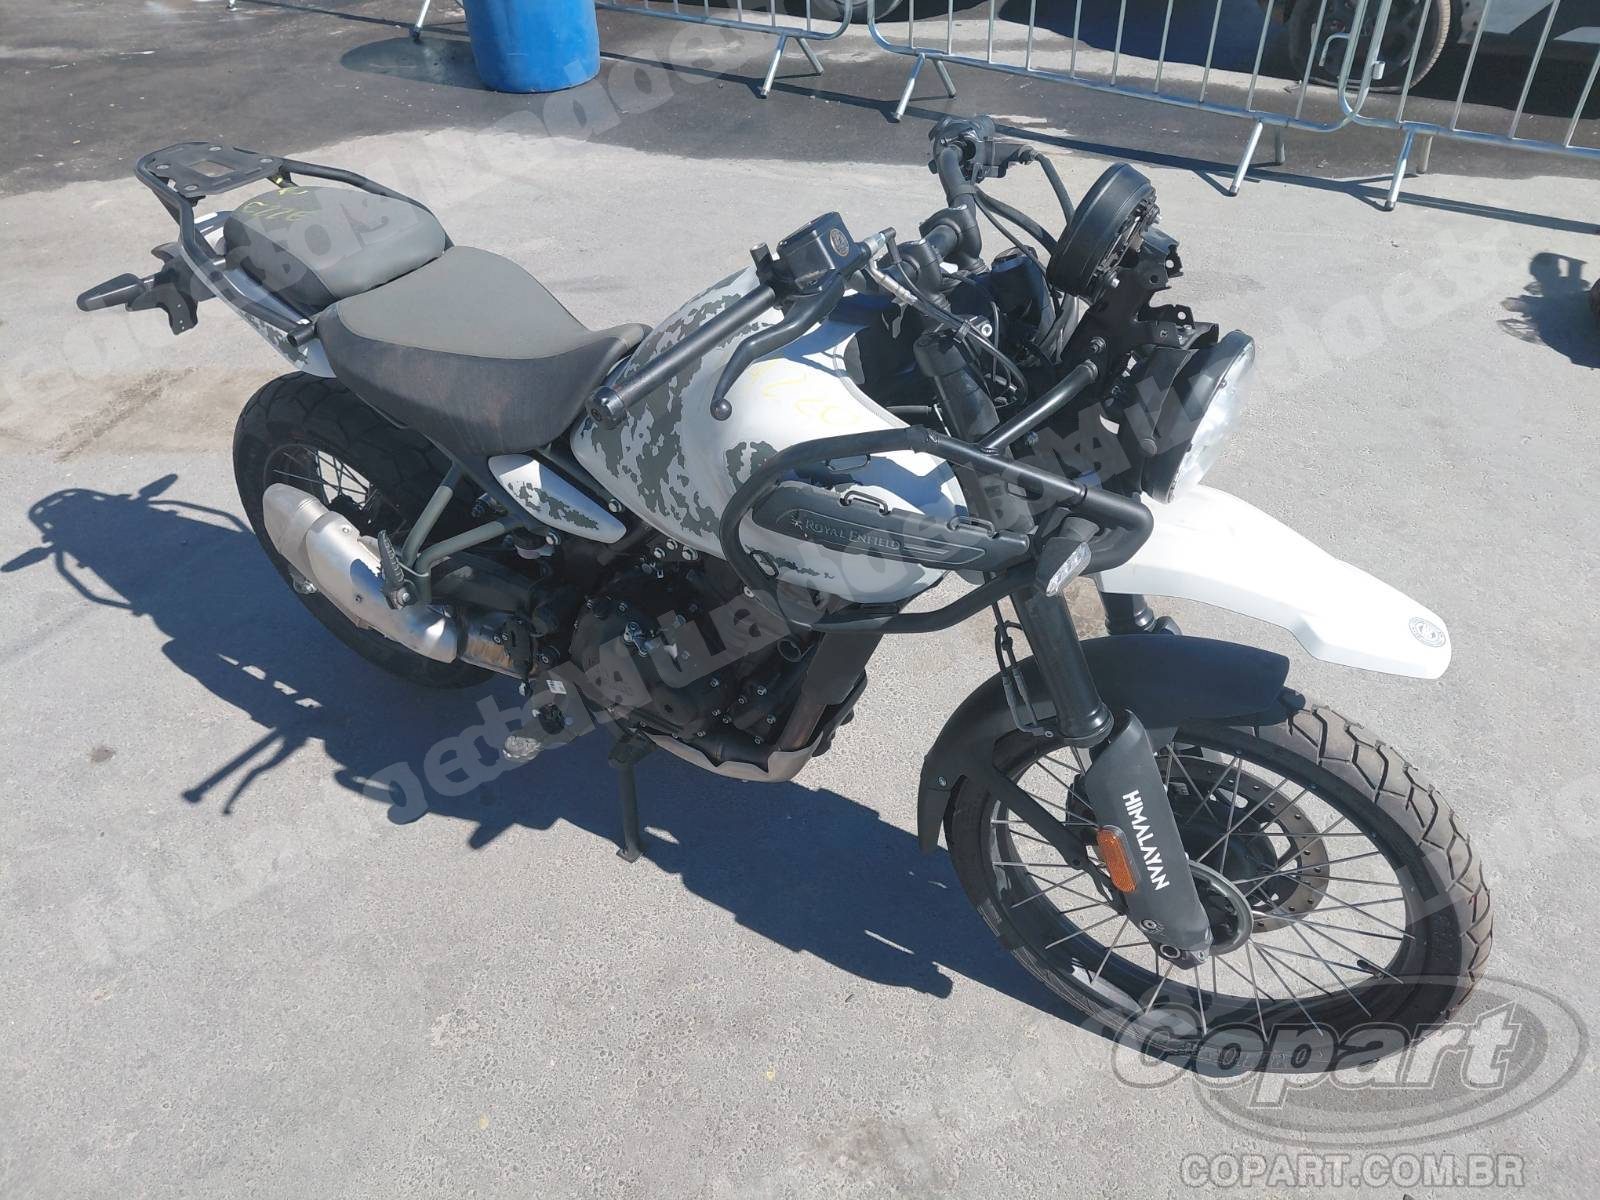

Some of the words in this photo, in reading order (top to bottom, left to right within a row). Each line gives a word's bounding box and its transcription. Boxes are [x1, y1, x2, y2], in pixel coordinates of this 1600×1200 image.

[806, 518, 846, 538] ROYAL
[849, 531, 901, 550] ENFIELD
[1122, 789, 1171, 891] HIMALAYAN
